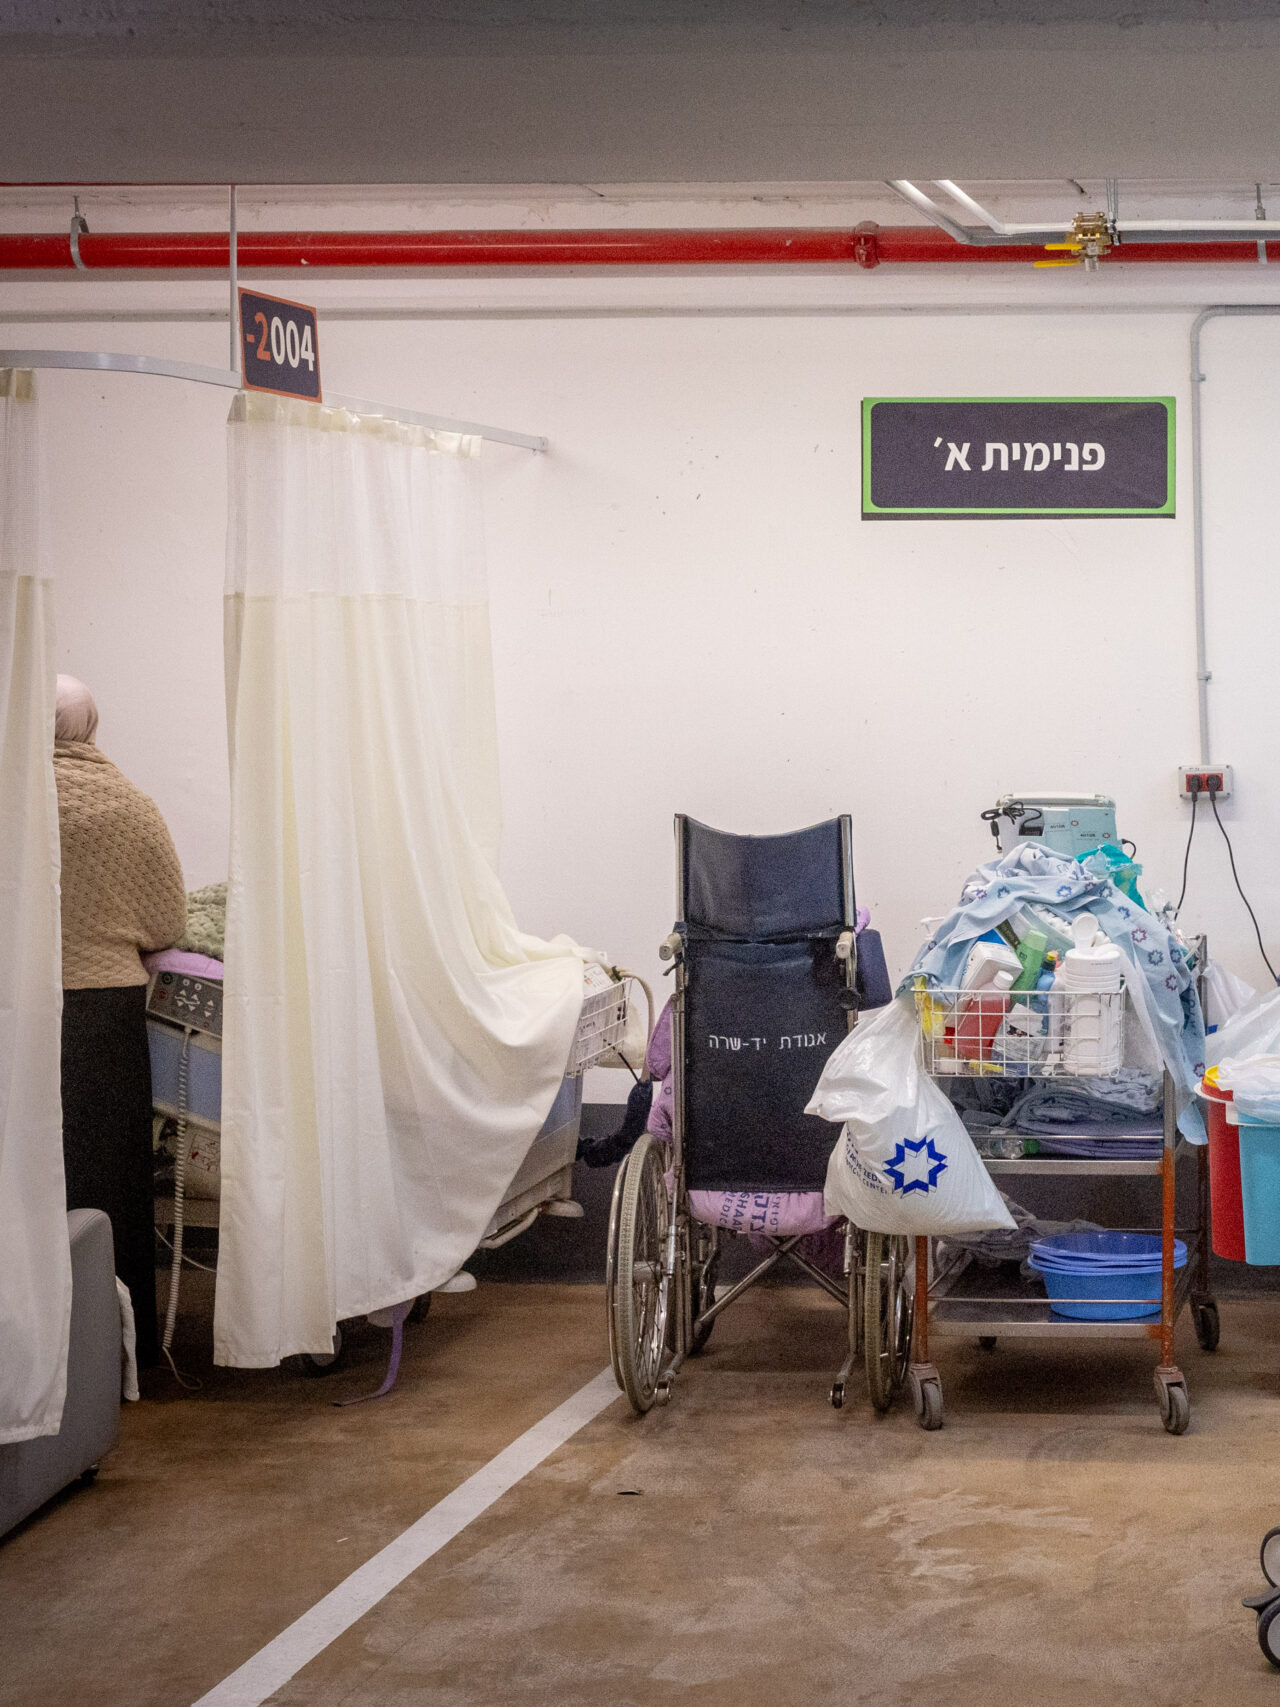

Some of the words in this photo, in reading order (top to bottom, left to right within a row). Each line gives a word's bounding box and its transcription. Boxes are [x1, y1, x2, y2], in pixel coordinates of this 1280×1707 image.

[245, 311, 315, 372] -2004
[981, 441, 1106, 472] פנימית
[709, 1035, 767, 1051] יד-שרה
[779, 1032, 827, 1050] אגודת
